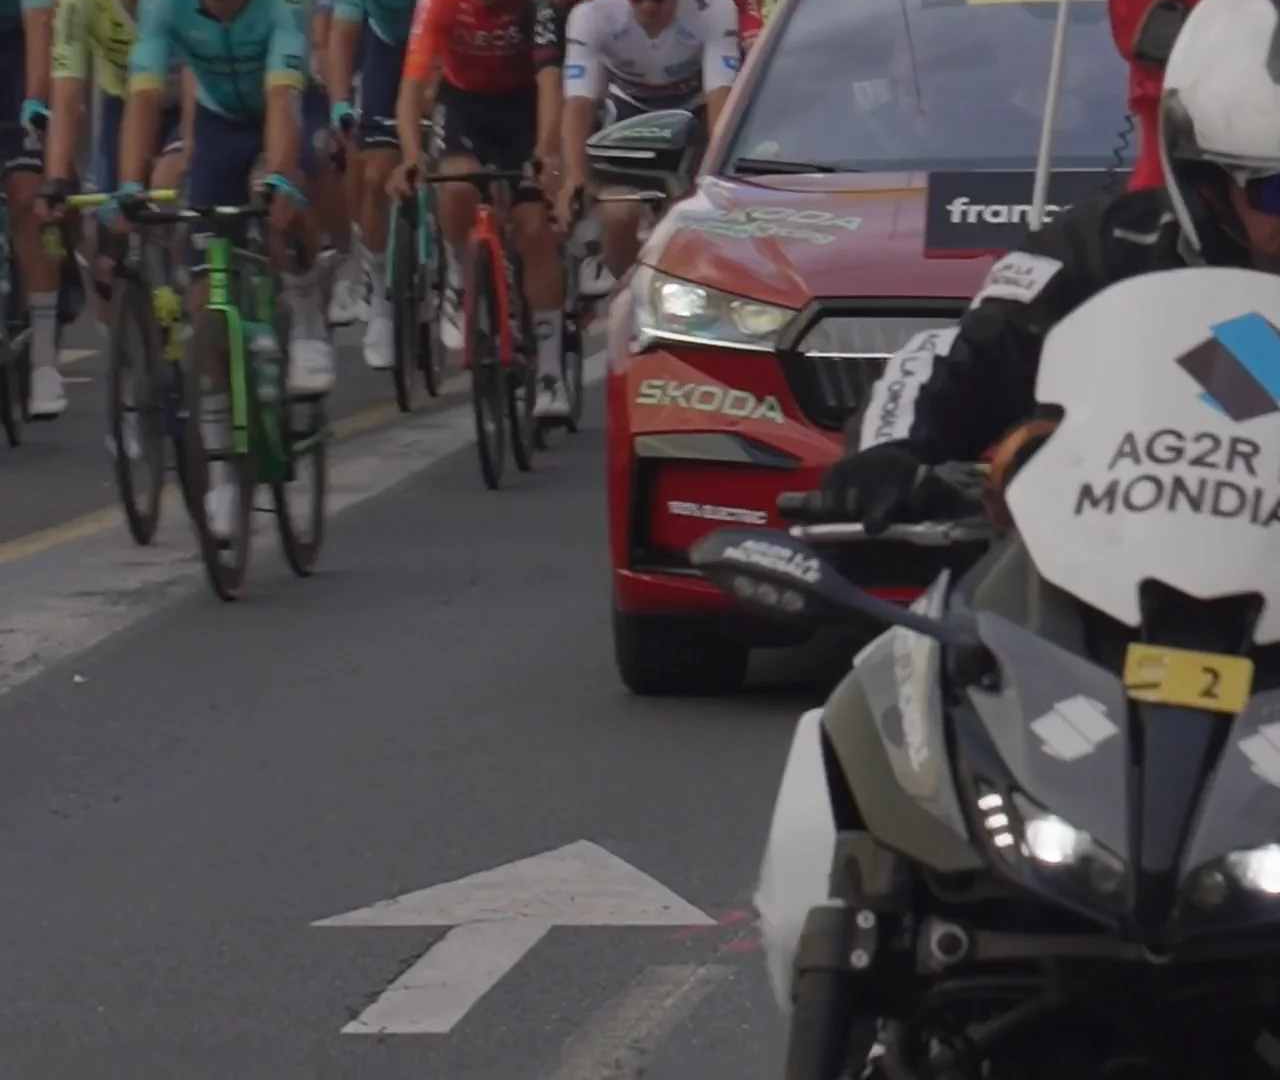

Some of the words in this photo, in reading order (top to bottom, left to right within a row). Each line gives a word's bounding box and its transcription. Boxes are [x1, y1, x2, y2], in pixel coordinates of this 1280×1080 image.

[946, 196, 1072, 224] franc
[635, 379, 785, 423] SKODA
[1108, 428, 1261, 477] AG2R
[1200, 666, 1221, 699] 2
